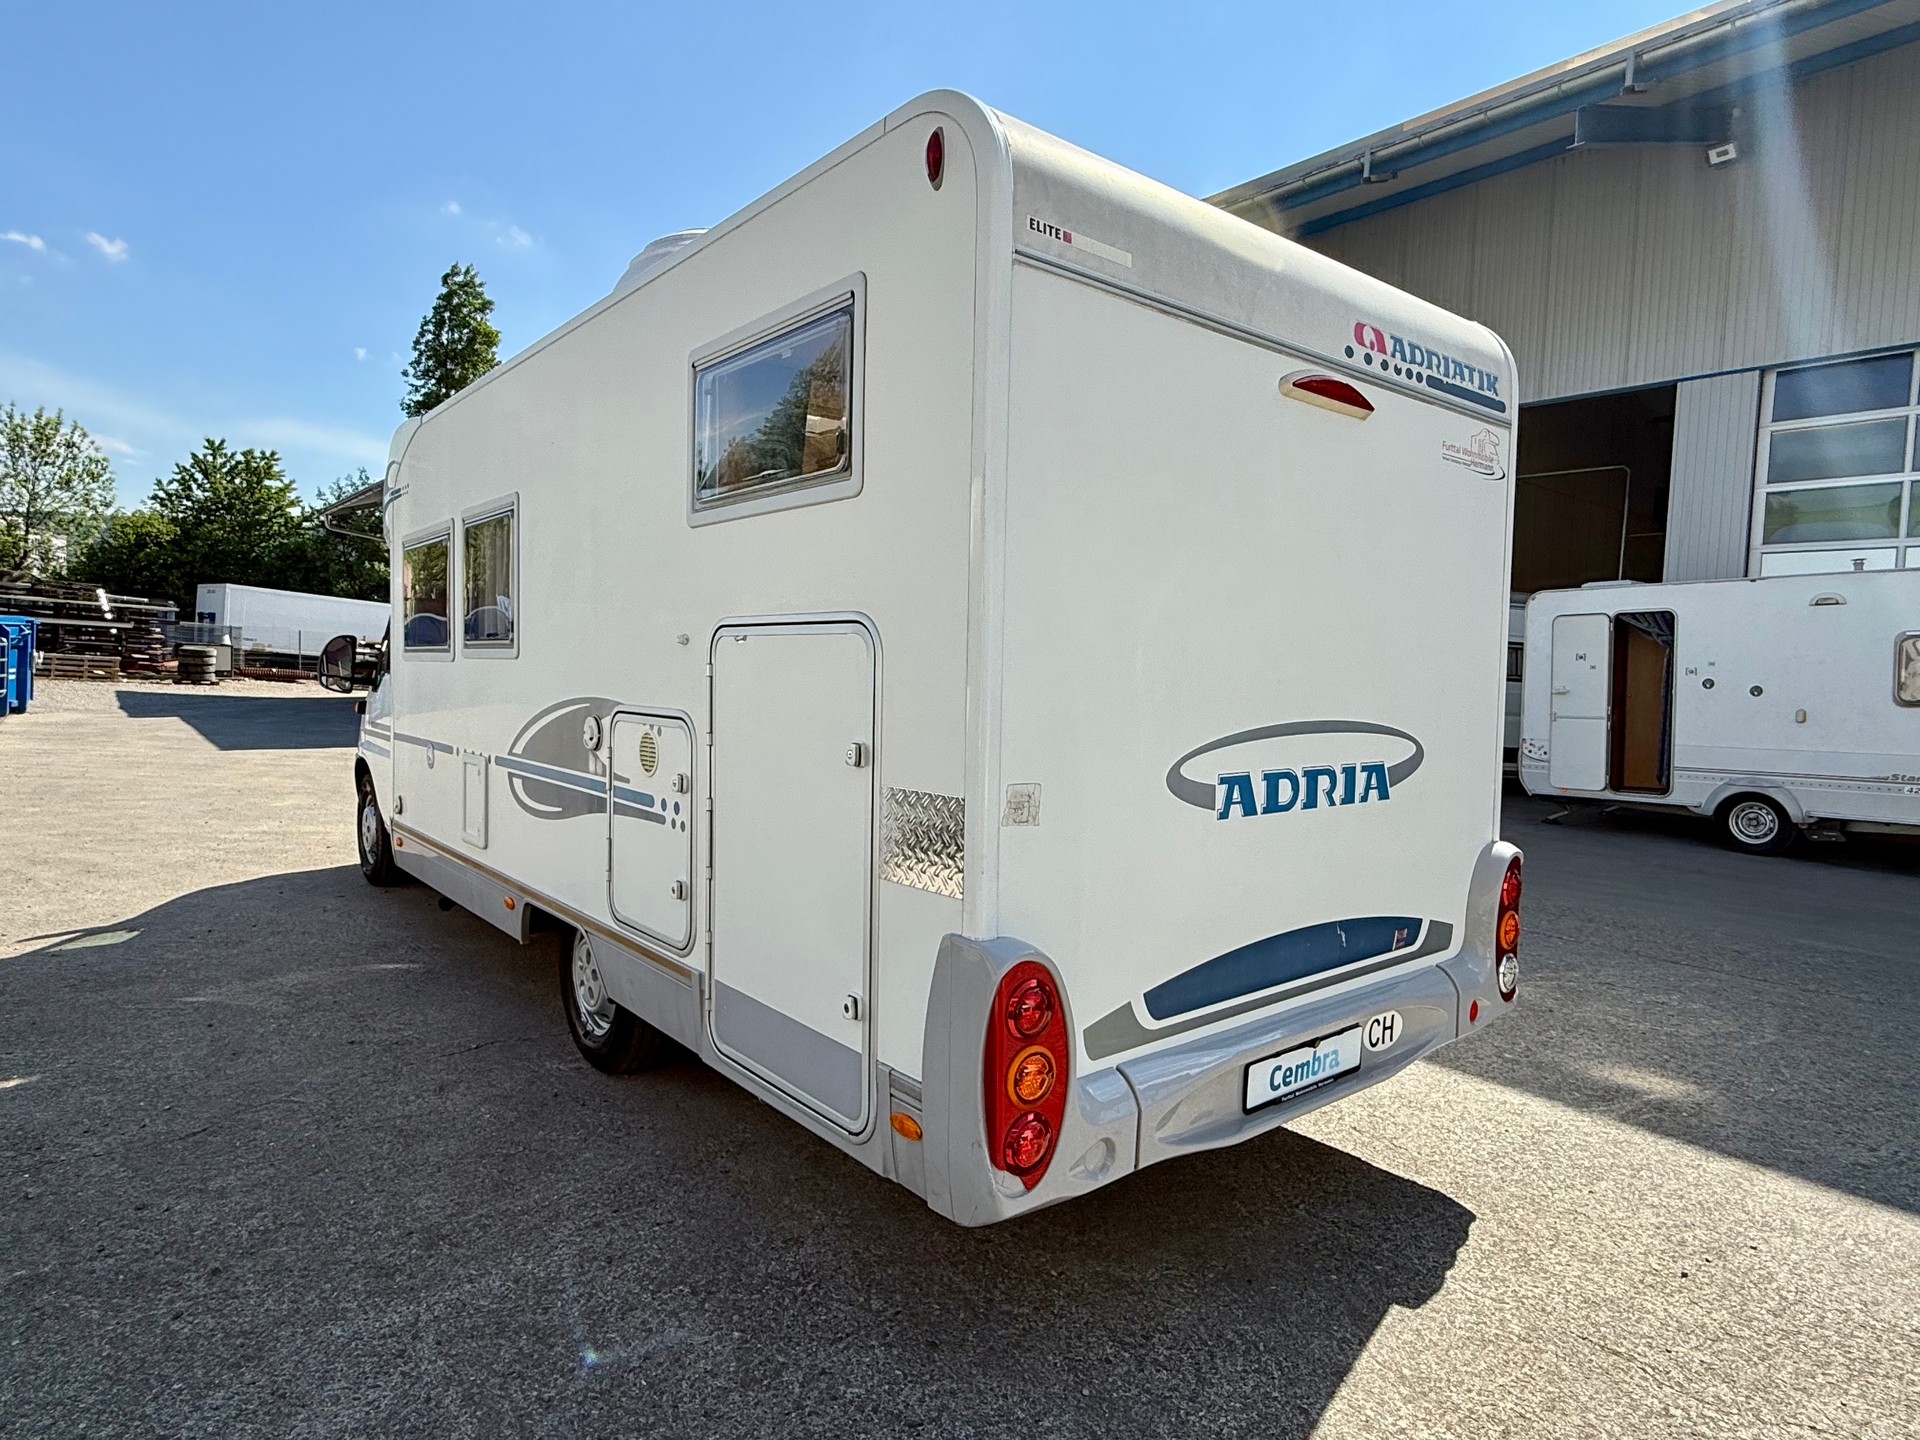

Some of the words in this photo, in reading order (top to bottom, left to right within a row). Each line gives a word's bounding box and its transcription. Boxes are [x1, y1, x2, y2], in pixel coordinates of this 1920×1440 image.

[1029, 217, 1062, 241] ELITE
[1390, 335, 1500, 397] ADRIATIK
[1216, 761, 1391, 821] ADRIA
[1368, 1014, 1395, 1048] CH
[1269, 1048, 1340, 1092] Cembra
